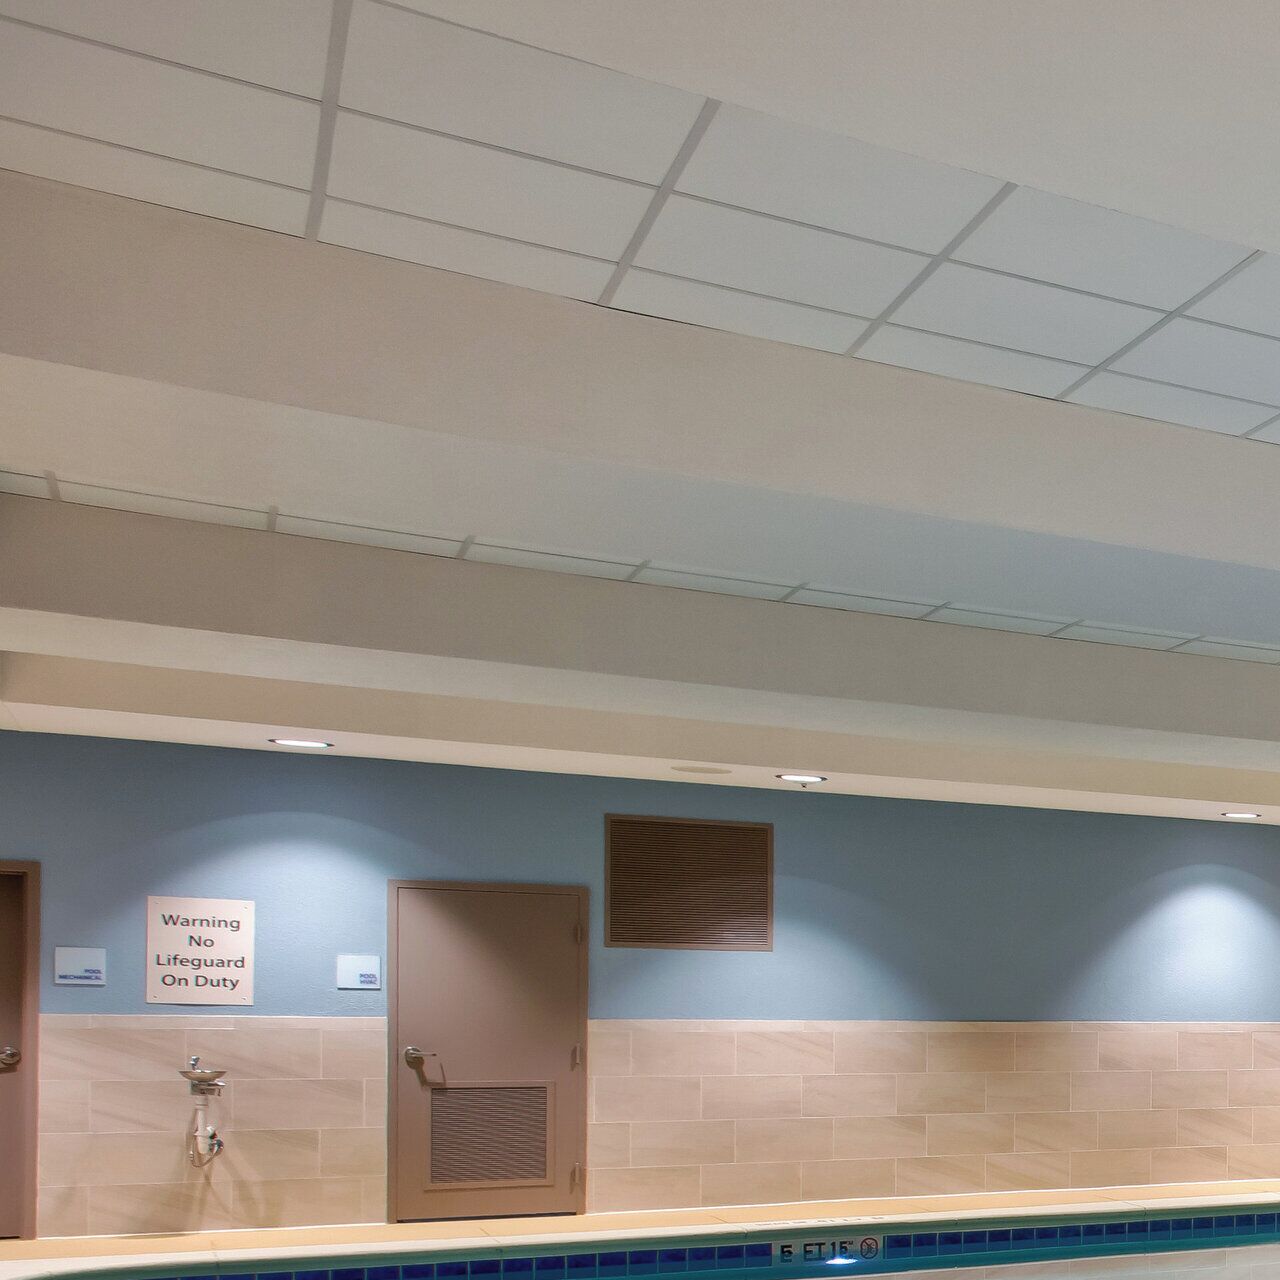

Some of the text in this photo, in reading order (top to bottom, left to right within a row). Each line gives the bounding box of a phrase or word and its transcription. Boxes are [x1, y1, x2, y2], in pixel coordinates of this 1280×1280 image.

[161, 913, 241, 932] Warning
[188, 935, 215, 948] No
[156, 953, 246, 971] Lifeguard
[161, 974, 240, 991] On Duty
